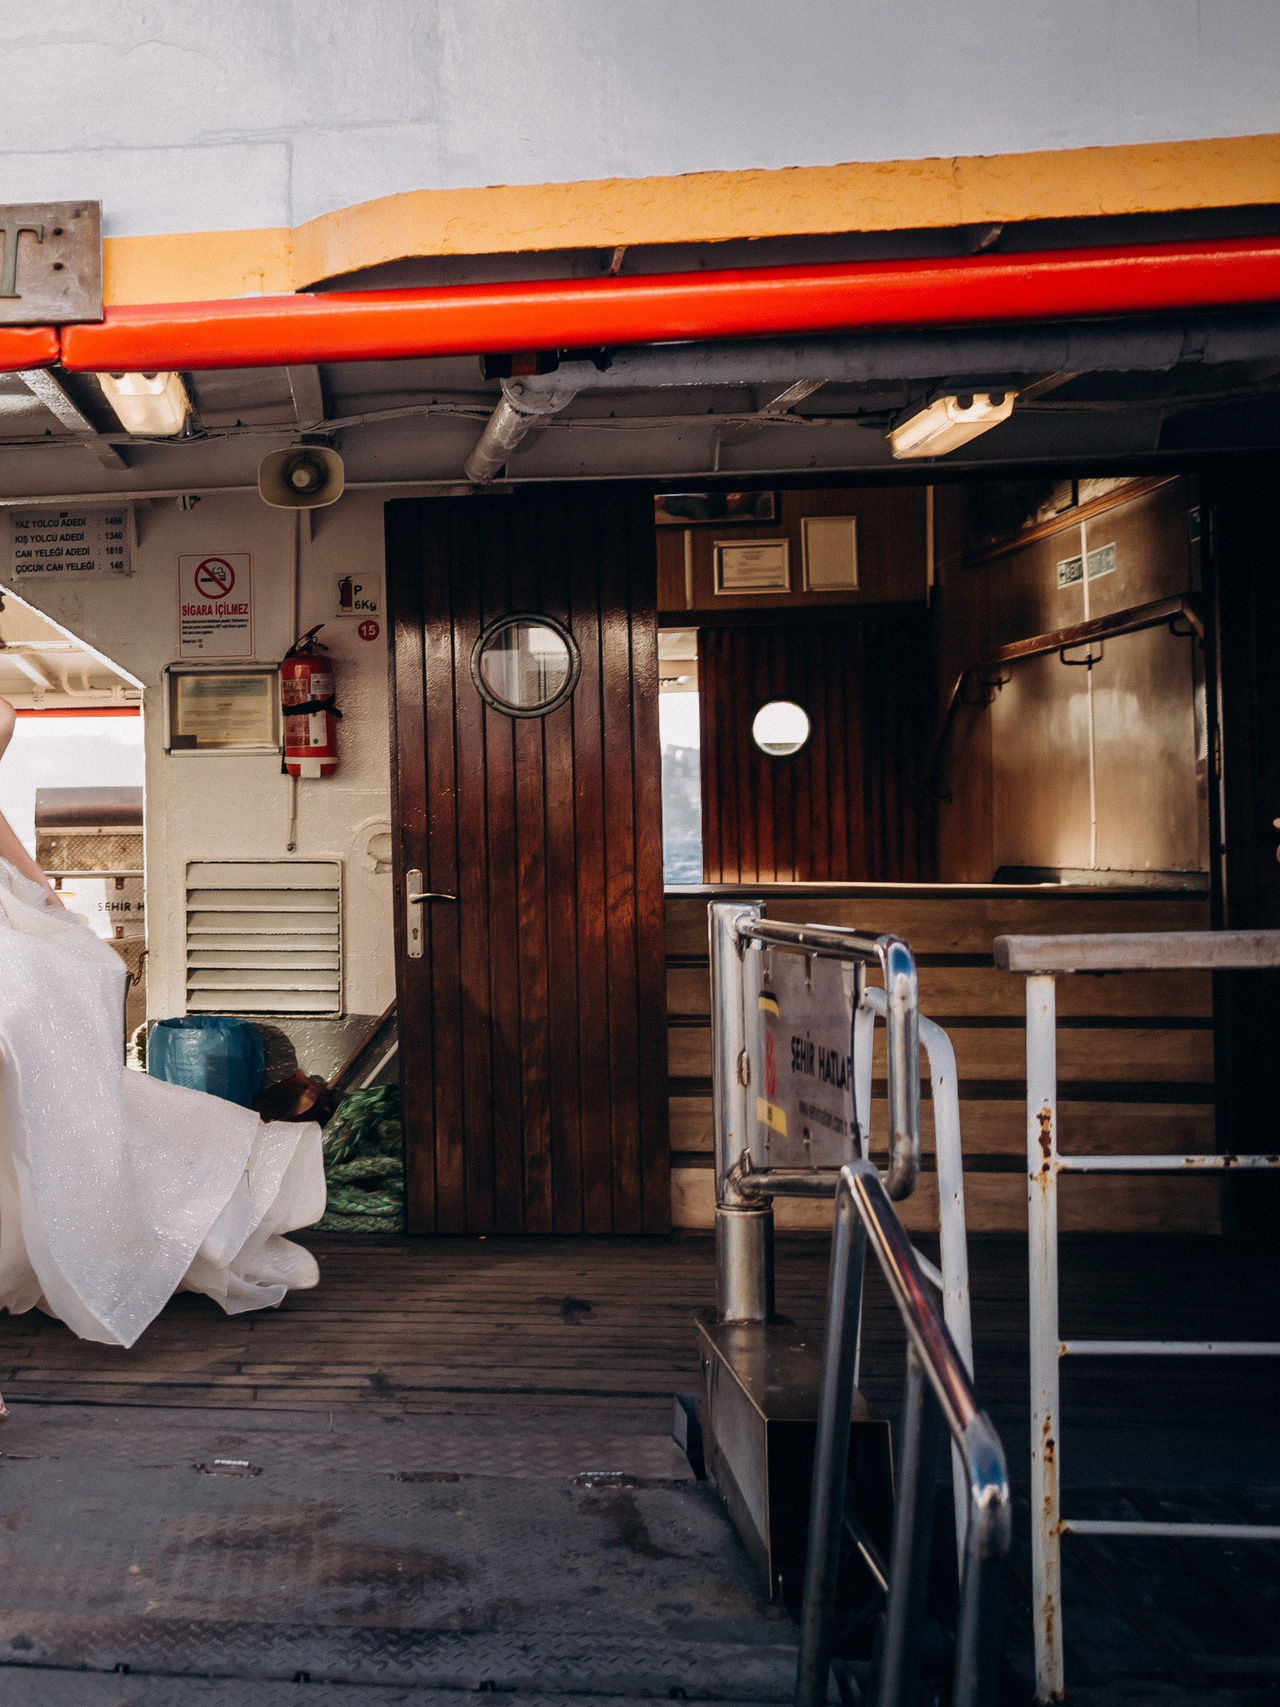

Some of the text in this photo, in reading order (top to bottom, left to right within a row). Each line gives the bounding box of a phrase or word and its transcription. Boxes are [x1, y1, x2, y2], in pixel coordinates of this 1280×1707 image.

[15, 520, 29, 529] YAZ
[32, 519, 59, 528] YOLCU
[61, 517, 86, 527] ADEDİ
[15, 535, 28, 545] KIŞ
[30, 534, 58, 543] YOLCU
[60, 532, 84, 542] ADEDİ
[15, 549, 32, 558] CAN
[34, 547, 63, 557] YELEĞİ
[65, 546, 90, 556] ADEDİ
[16, 564, 44, 575] ÇOCUK
[46, 563, 64, 571] CAN
[66, 561, 95, 571] YELEĞİ
[109, 561, 124, 569] 145
[354, 585, 363, 595] P
[182, 601, 249, 618] SİGARA İÇİLMEZ
[354, 600, 377, 611] 6Kg
[360, 625, 376, 636] 15
[791, 1030, 815, 1076] ŞEHİR
